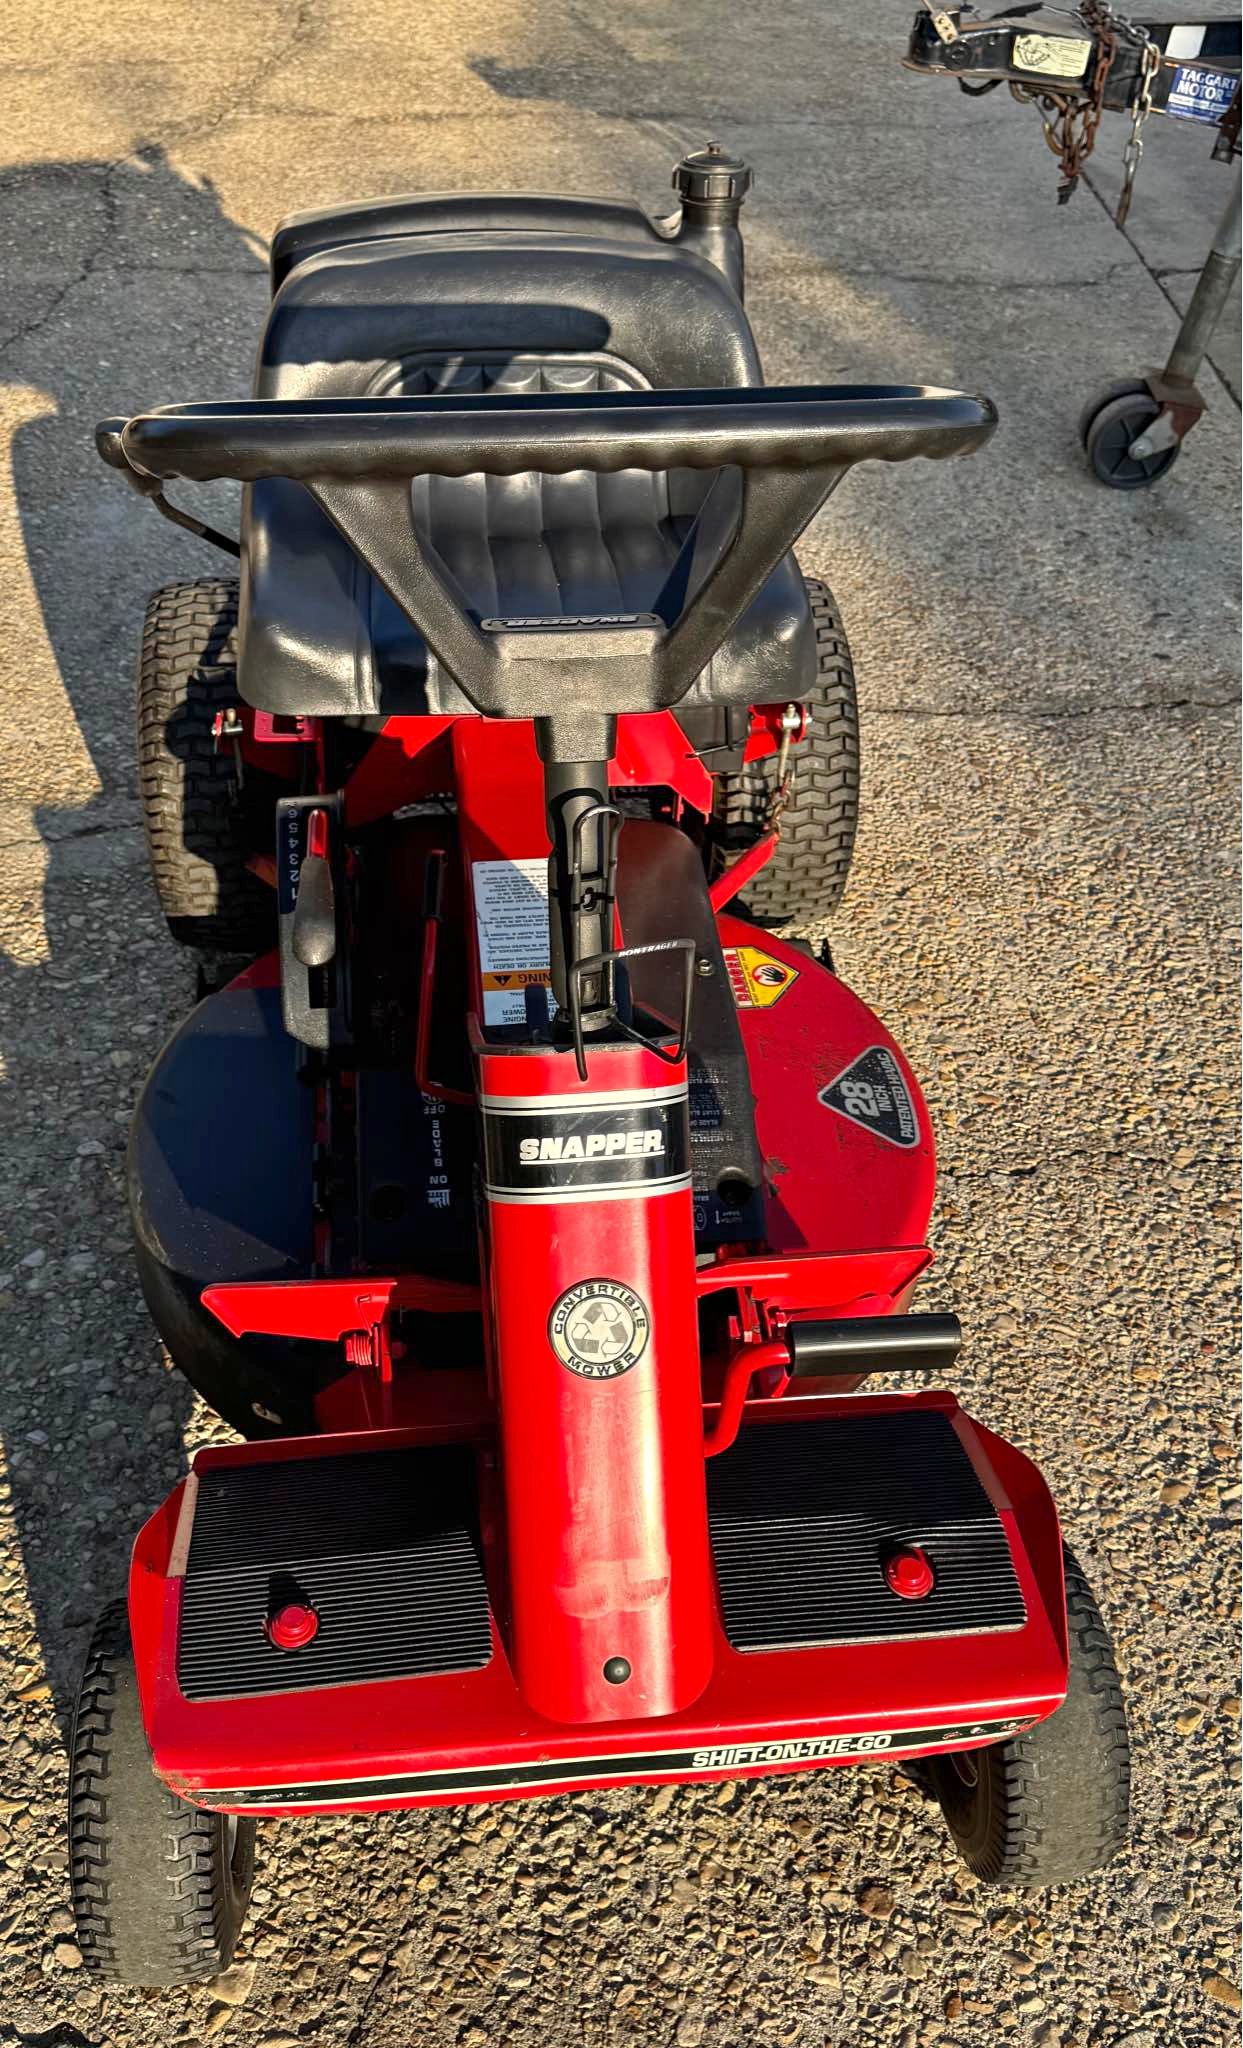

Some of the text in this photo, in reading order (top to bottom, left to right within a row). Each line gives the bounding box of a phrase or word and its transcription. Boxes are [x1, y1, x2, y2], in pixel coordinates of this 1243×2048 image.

[1182, 68, 1237, 90] TAGGART
[1176, 80, 1225, 101] MOTOR
[505, 615, 640, 627] SNAPPER
[289, 822, 298, 833] 5
[289, 853, 299, 865] 3
[290, 870, 299, 882] 2
[291, 887, 298, 900] 1
[618, 940, 678, 958] BONTRAGER
[518, 972, 551, 984] NING
[724, 953, 751, 1002] DANGER
[503, 1015, 527, 1023] NGINE
[839, 1080, 881, 1118] 28
[873, 1085, 894, 1113] INCH
[877, 1052, 915, 1139] PATENTED HI-VAC
[429, 1175, 448, 1184] ON
[554, 1283, 646, 1335] CONVERTIBLE
[567, 1352, 637, 1377] MOWER
[692, 1734, 892, 1768] SHIFT-ON-THE-GO
